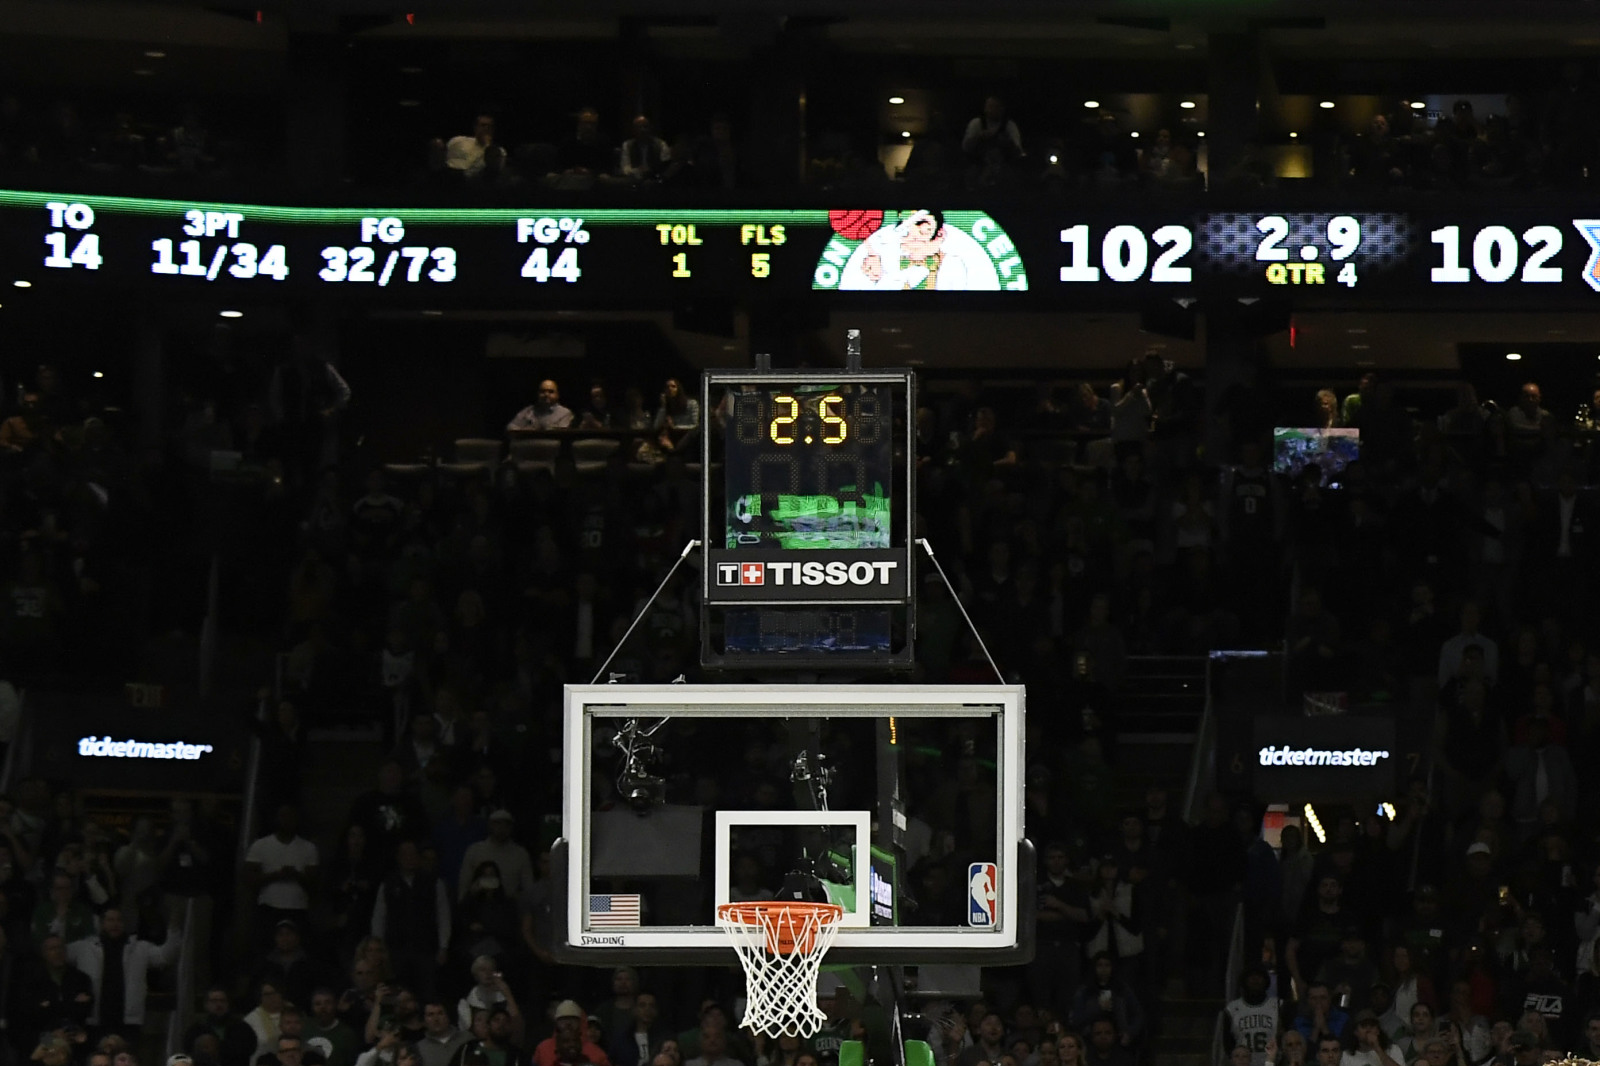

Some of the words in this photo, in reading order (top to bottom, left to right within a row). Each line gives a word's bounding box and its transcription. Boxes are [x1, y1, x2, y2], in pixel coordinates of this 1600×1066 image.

[47, 203, 94, 229] TO
[183, 210, 243, 240] 3PT
[361, 217, 405, 243] FG
[516, 216, 590, 246] FG%
[656, 224, 703, 246] TOL
[741, 224, 786, 247] FLS
[1254, 216, 1361, 262] 2.9
[45, 233, 102, 271] 14
[152, 239, 289, 282] 11/34
[1060, 225, 1193, 282] 102
[1430, 226, 1563, 282] 102
[319, 246, 457, 286] 32/73
[520, 247, 581, 283] 44
[672, 254, 691, 278] 1
[751, 253, 770, 278] 5
[1266, 263, 1325, 285] QTR
[1336, 263, 1357, 287] 4
[771, 396, 847, 444] 2.5
[767, 562, 897, 585] TISSOT
[79, 736, 205, 759] ticketmaster
[1259, 745, 1383, 767] ticketmaster
[972, 912, 986, 923] NBA
[581, 935, 625, 946] SPALDING
[1524, 993, 1562, 1013] FILA
[1239, 1016, 1273, 1031] CELTICS
[1246, 1032, 1266, 1052] 16
